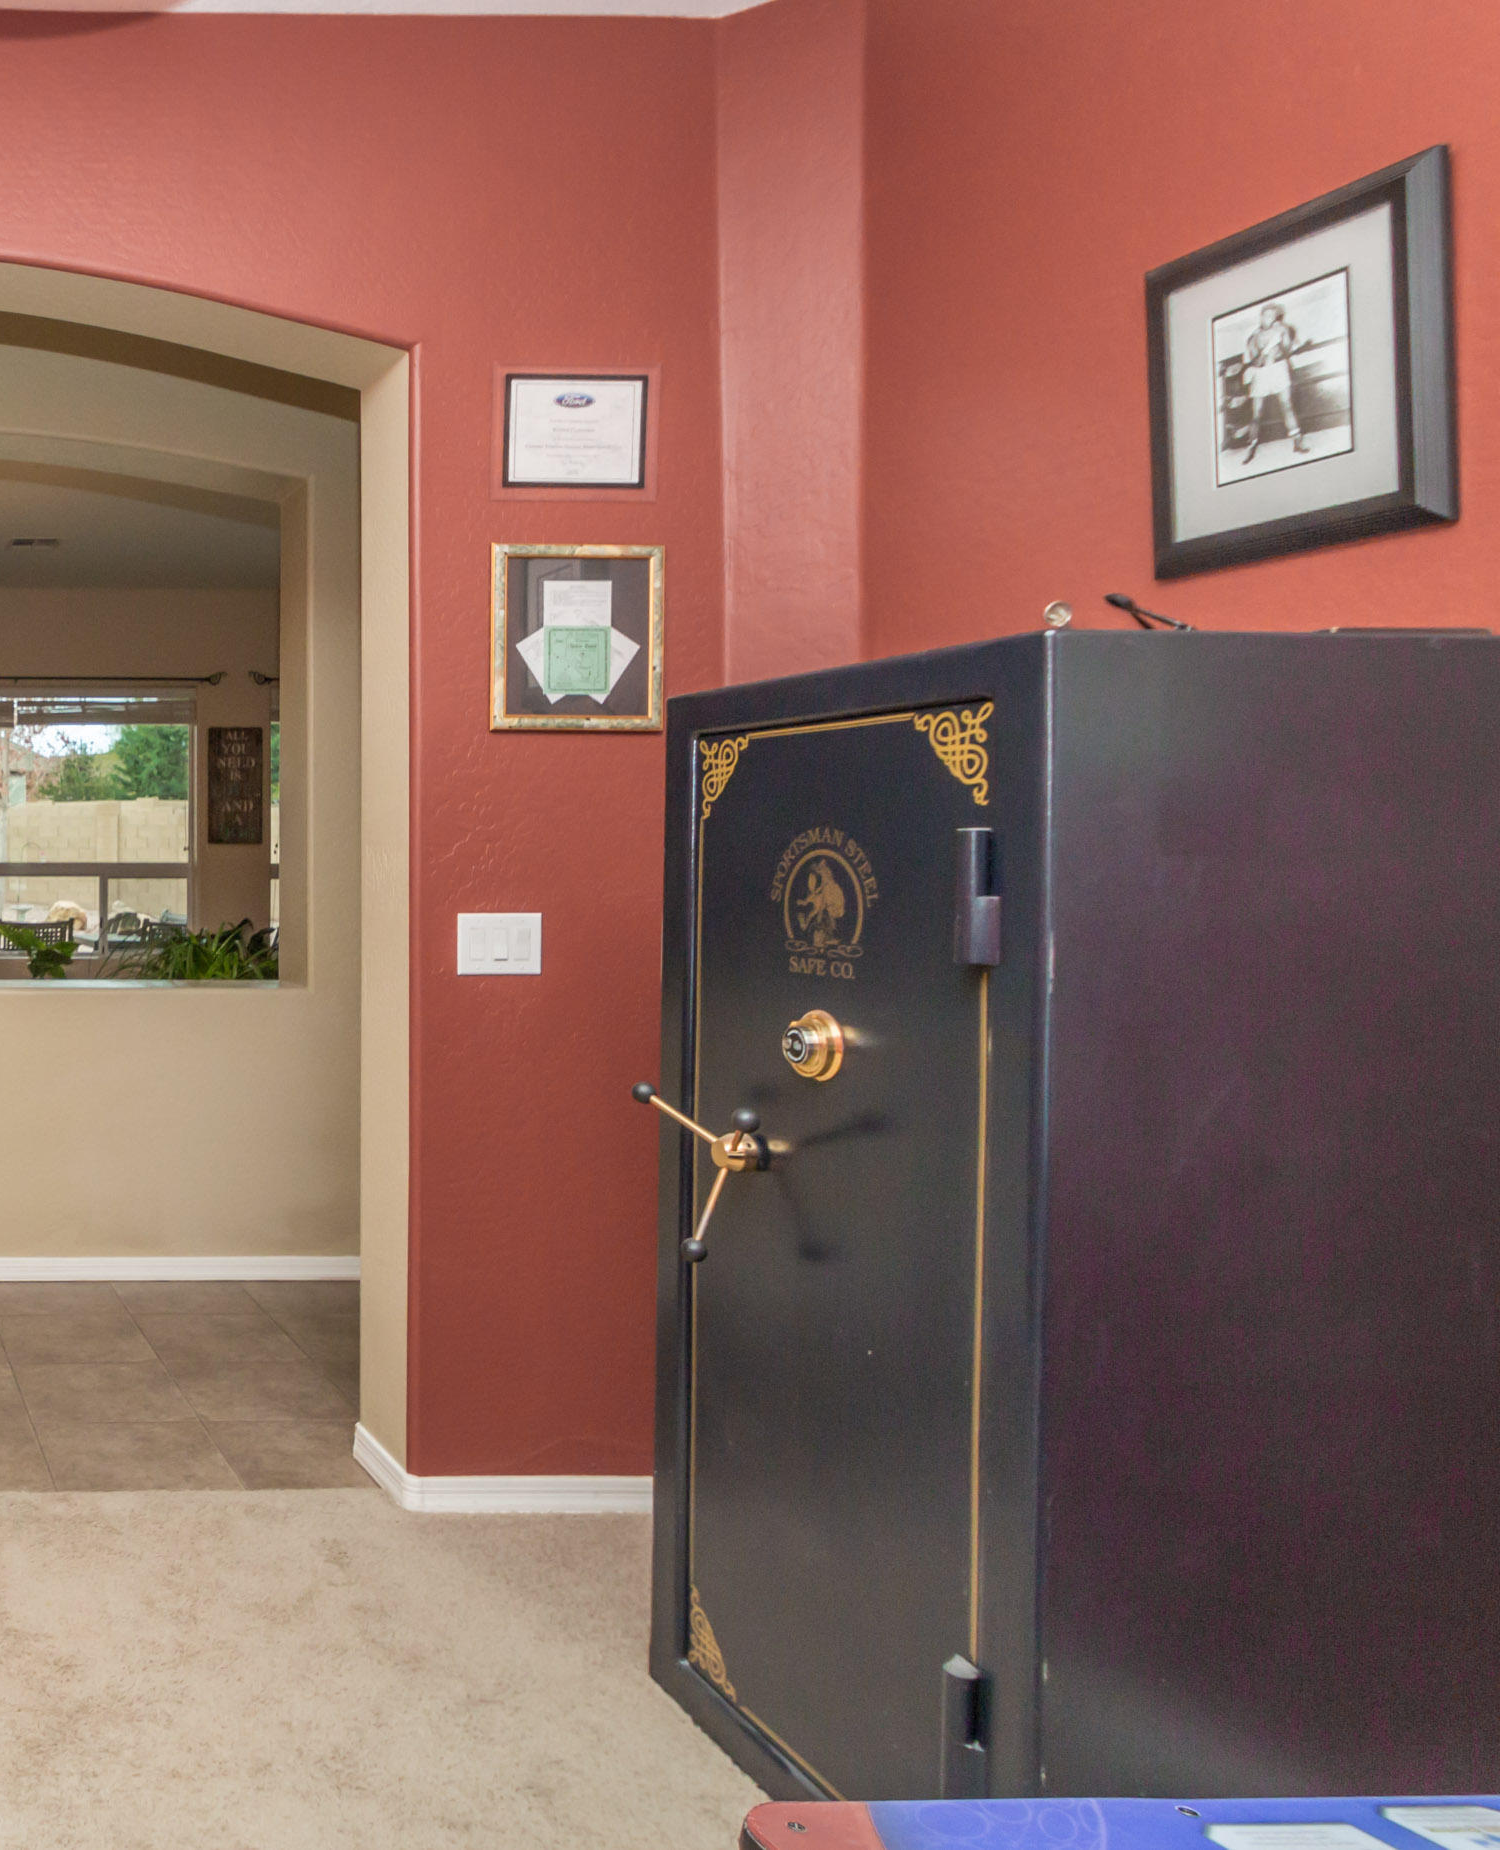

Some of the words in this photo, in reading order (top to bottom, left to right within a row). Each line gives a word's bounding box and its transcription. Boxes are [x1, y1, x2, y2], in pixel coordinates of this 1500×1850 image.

[226, 731, 249, 741] ALL
[221, 743, 251, 754] YOU
[218, 757, 256, 768] NEED
[222, 799, 254, 812] AND
[770, 826, 845, 903] SPORTSMAN
[843, 837, 881, 908] STEEL
[788, 956, 827, 976] SAFE
[830, 961, 856, 979] CO.
